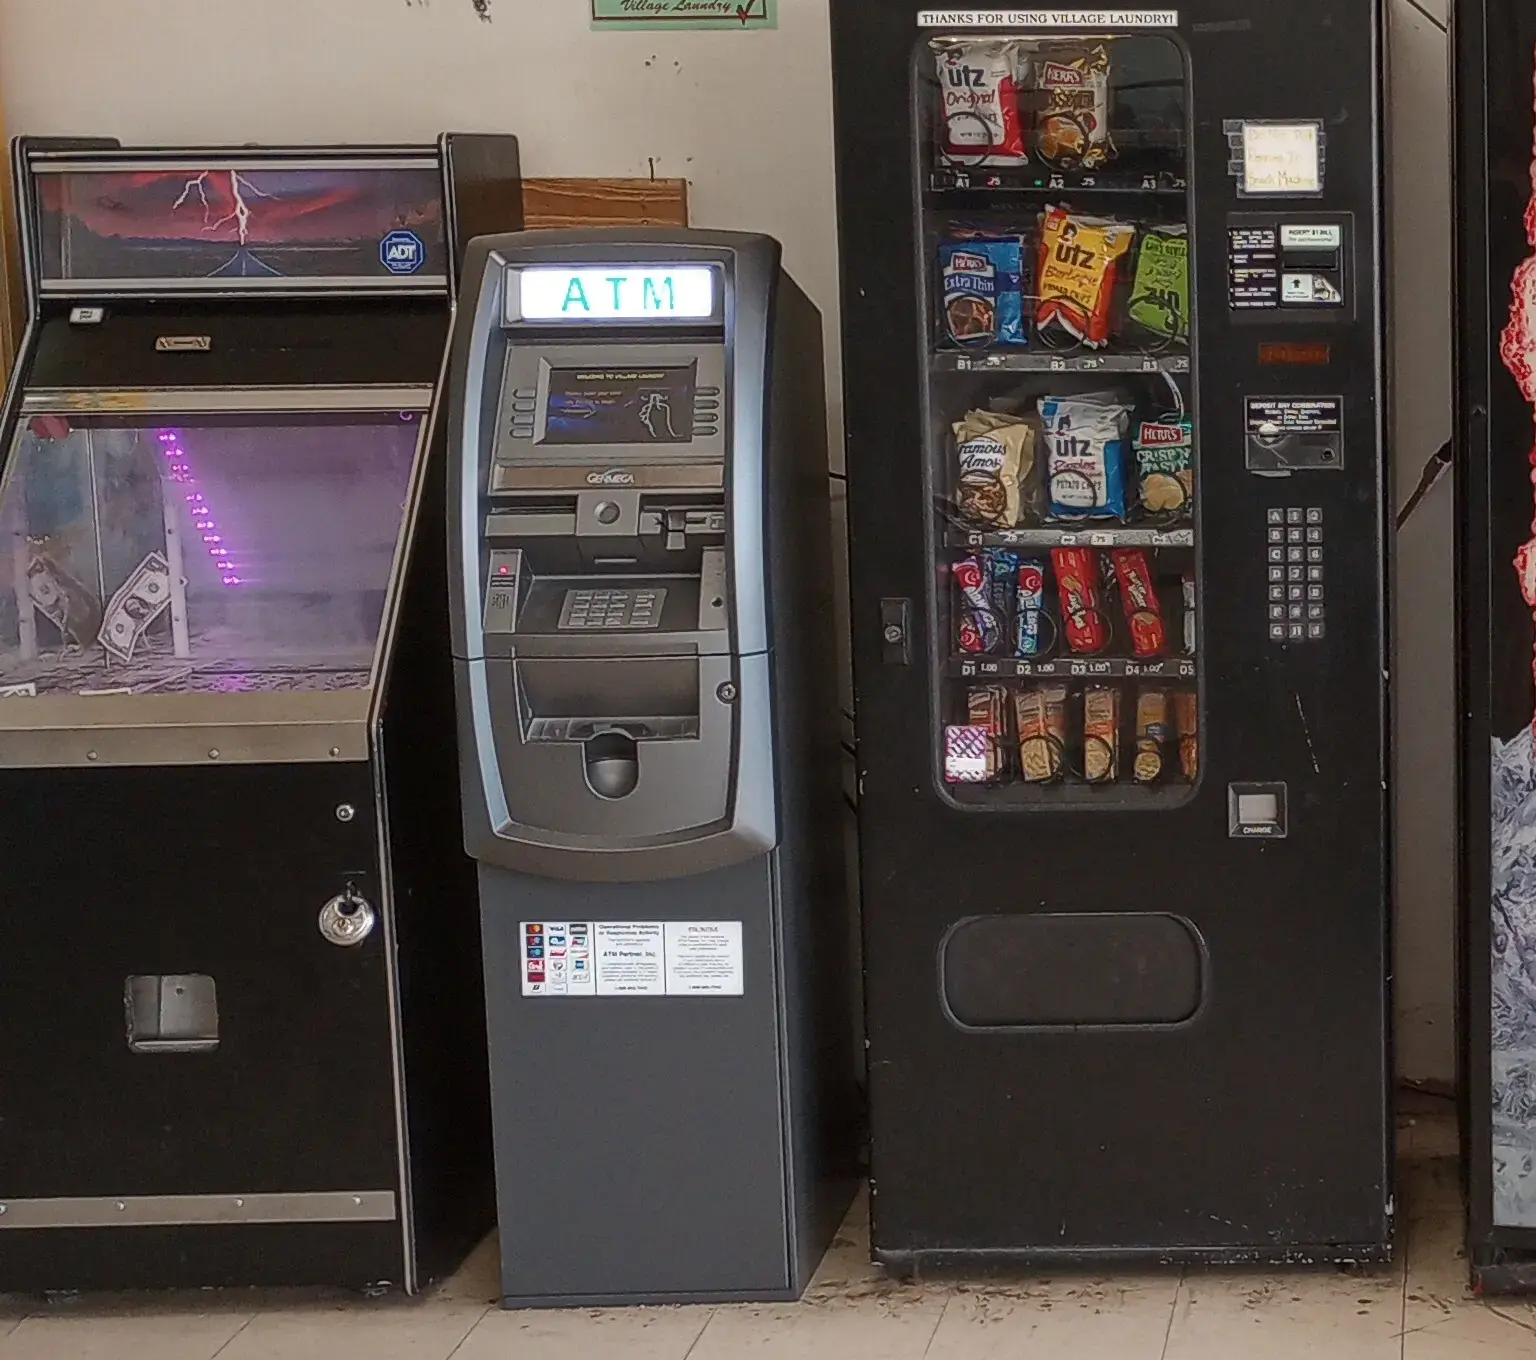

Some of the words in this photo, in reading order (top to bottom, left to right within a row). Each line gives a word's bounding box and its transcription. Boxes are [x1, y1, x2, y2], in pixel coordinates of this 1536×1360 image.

[922, 14, 974, 25] THANKS
[977, 14, 1003, 25] FOR
[1008, 14, 1048, 25] USING
[1052, 14, 1106, 25] VILLAGE
[956, 176, 970, 188] A1
[1050, 176, 1064, 189] A2
[1141, 177, 1156, 189] A3
[387, 244, 417, 260] ADT
[944, 274, 972, 290] Extra
[973, 275, 995, 293] Thin
[561, 277, 674, 311] ATM
[957, 359, 971, 371] B1
[1050, 359, 1066, 371] B2
[969, 534, 983, 545] C1
[1061, 534, 1076, 546] C2
[962, 664, 976, 676] D1
[980, 662, 998, 672] 1.00
[1016, 663, 1031, 675] D2
[1037, 663, 1055, 673] 1.00
[1071, 663, 1087, 676] D3
[1125, 664, 1140, 675] D4
[1179, 663, 1195, 675] D5
